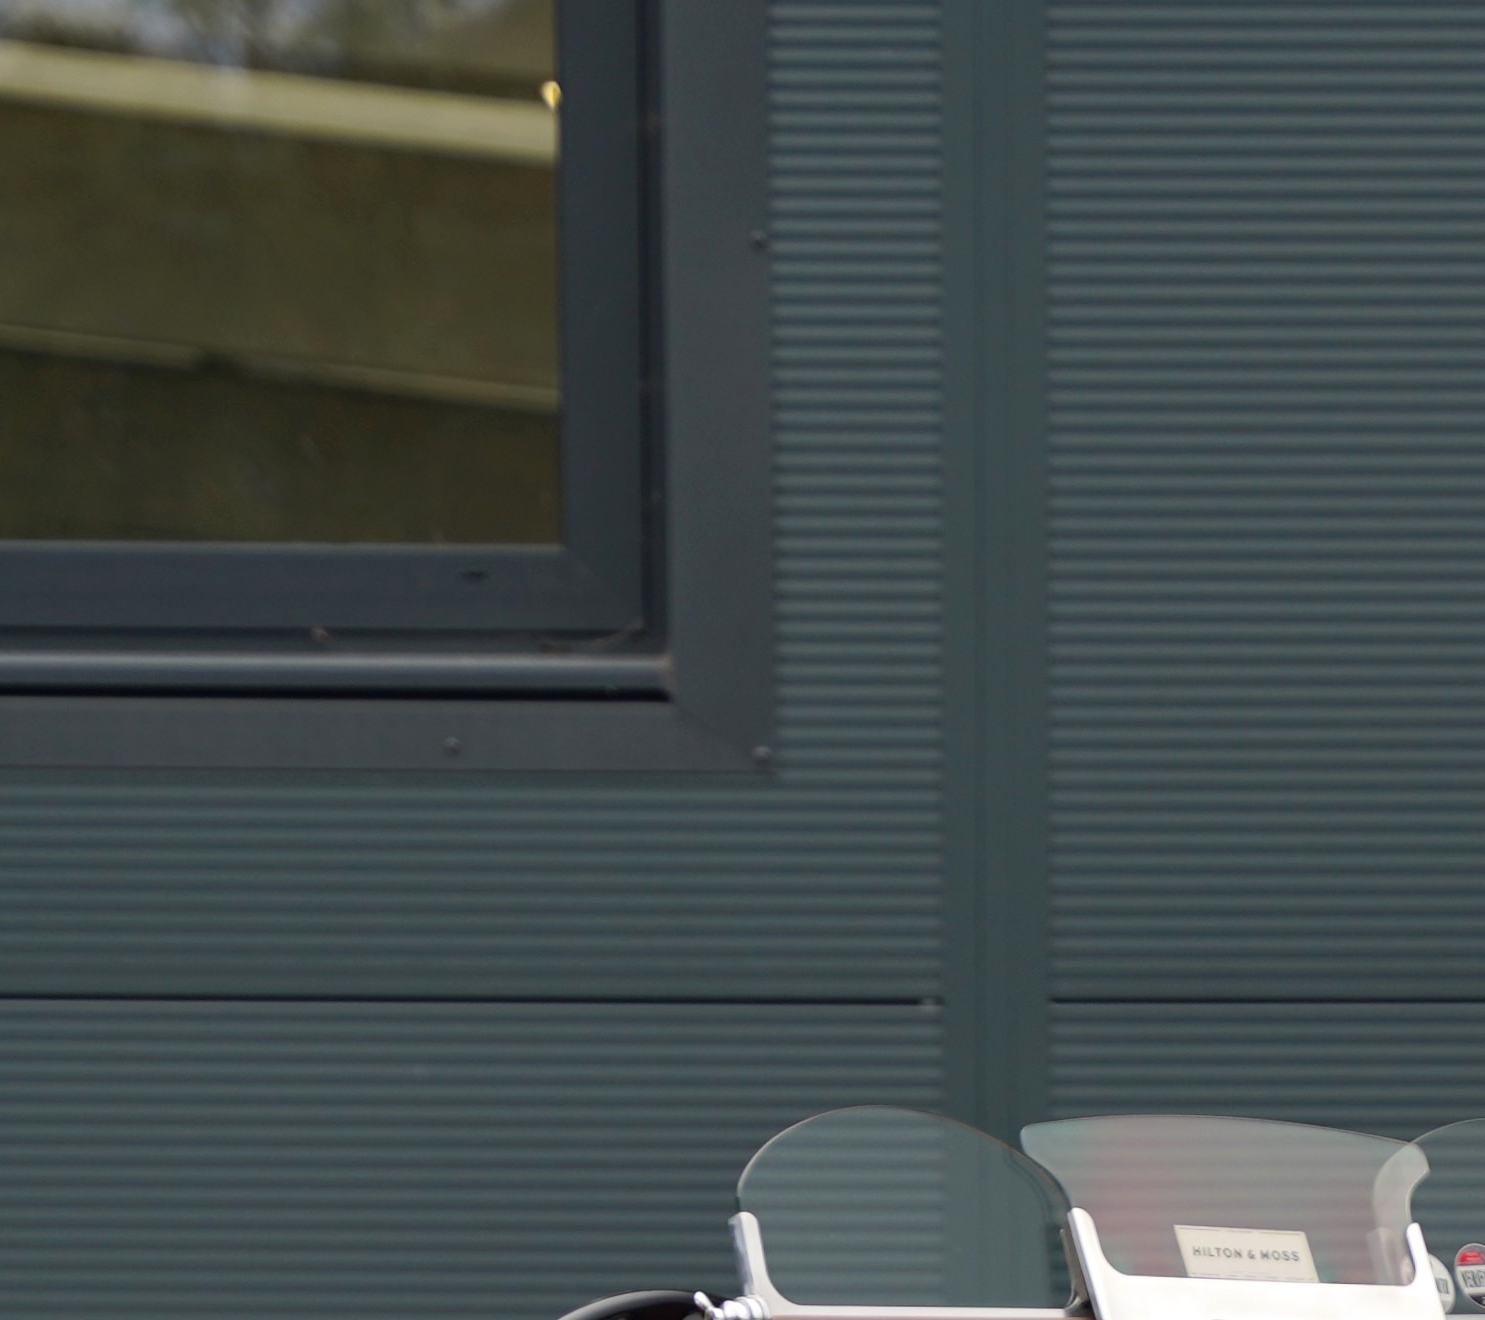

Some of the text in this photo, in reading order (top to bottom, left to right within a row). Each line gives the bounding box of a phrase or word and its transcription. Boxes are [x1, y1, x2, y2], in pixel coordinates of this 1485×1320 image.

[1191, 1245, 1301, 1263] HILTON & MOSS
